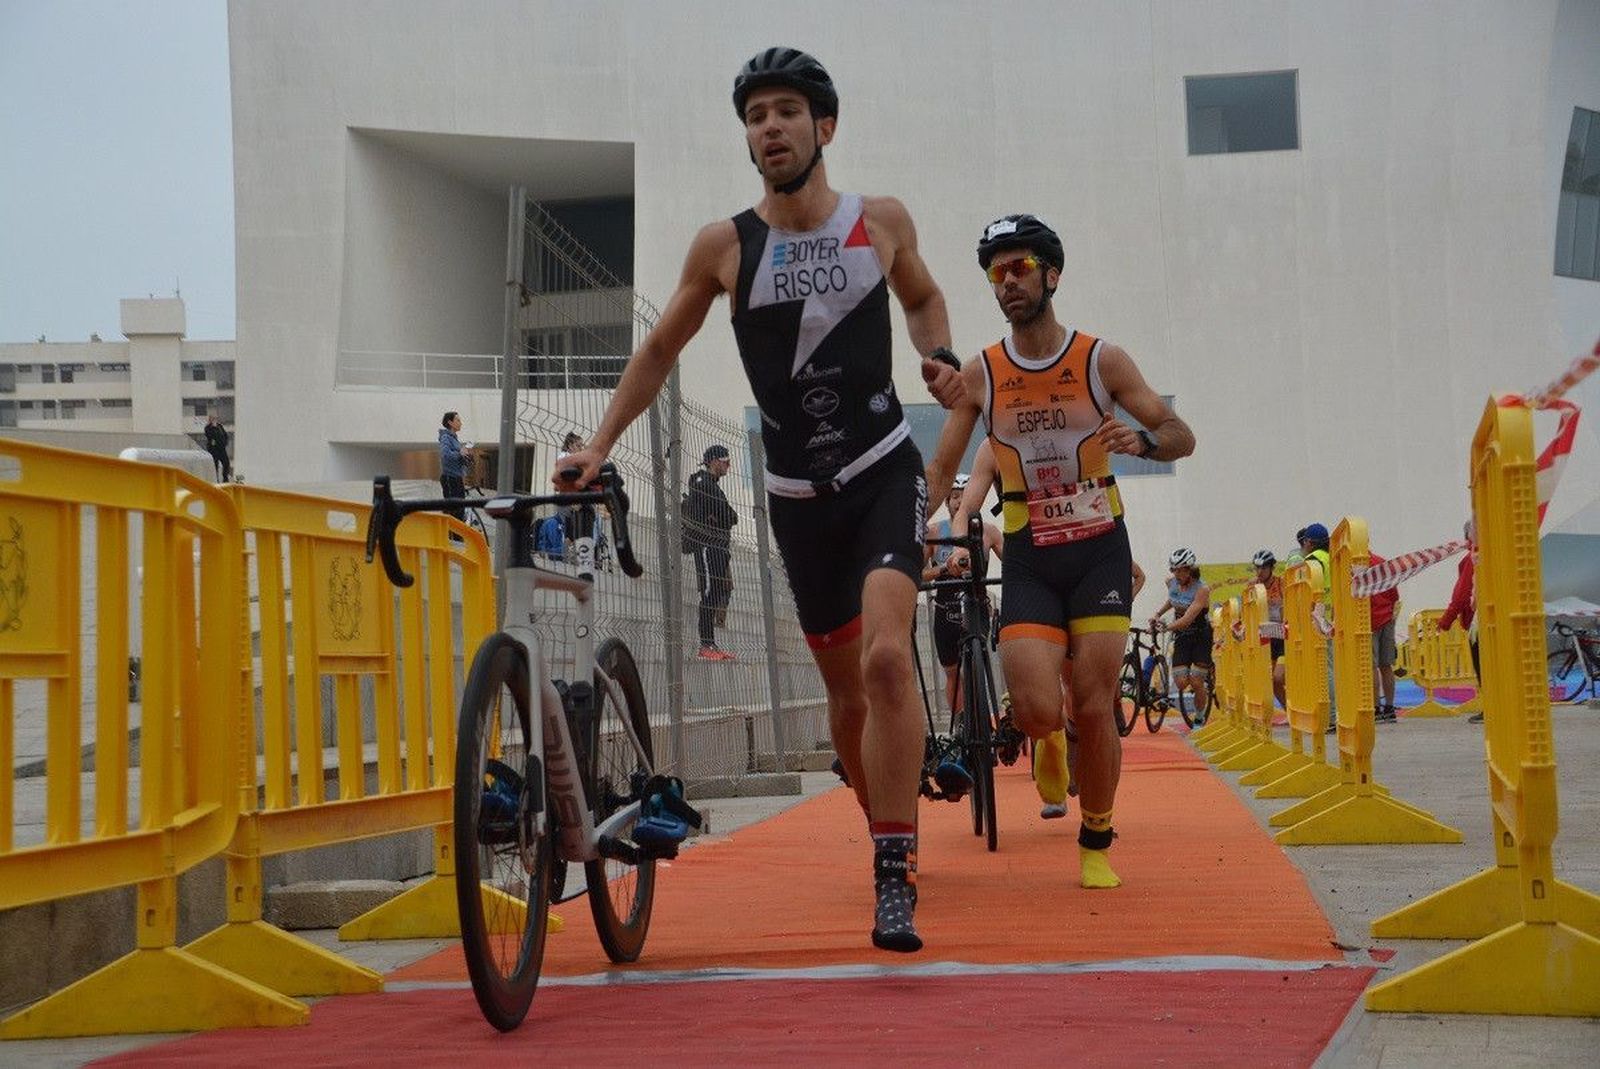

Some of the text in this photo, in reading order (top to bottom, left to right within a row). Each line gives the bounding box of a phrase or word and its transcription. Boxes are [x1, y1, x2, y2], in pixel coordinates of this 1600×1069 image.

[773, 265, 847, 300] RISCO
[1016, 408, 1066, 433] ESPEJO
[1044, 501, 1074, 519] 014
